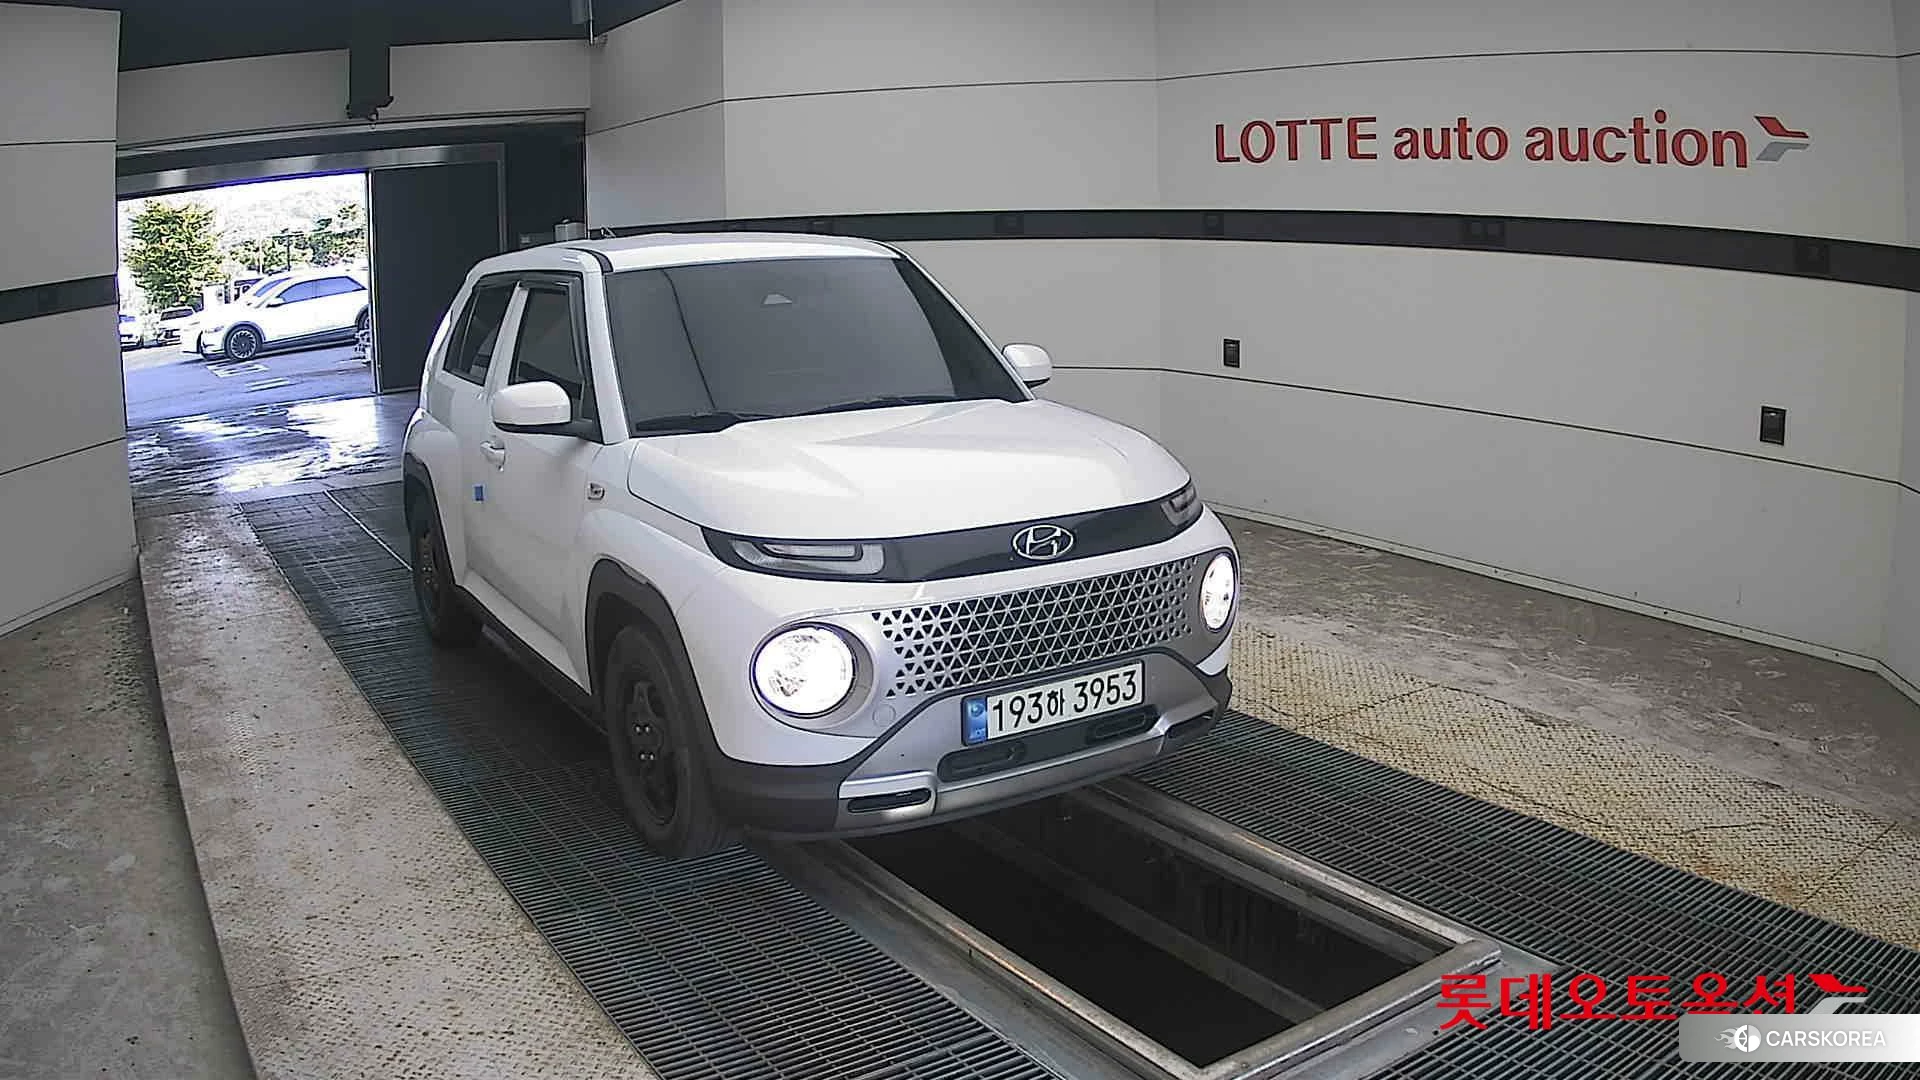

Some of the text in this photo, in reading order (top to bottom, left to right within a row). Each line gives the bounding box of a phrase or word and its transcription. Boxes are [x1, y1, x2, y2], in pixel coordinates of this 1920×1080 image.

[1215, 109, 1748, 168] LOTTE auto auction
[992, 670, 1137, 731] 193하 3953
